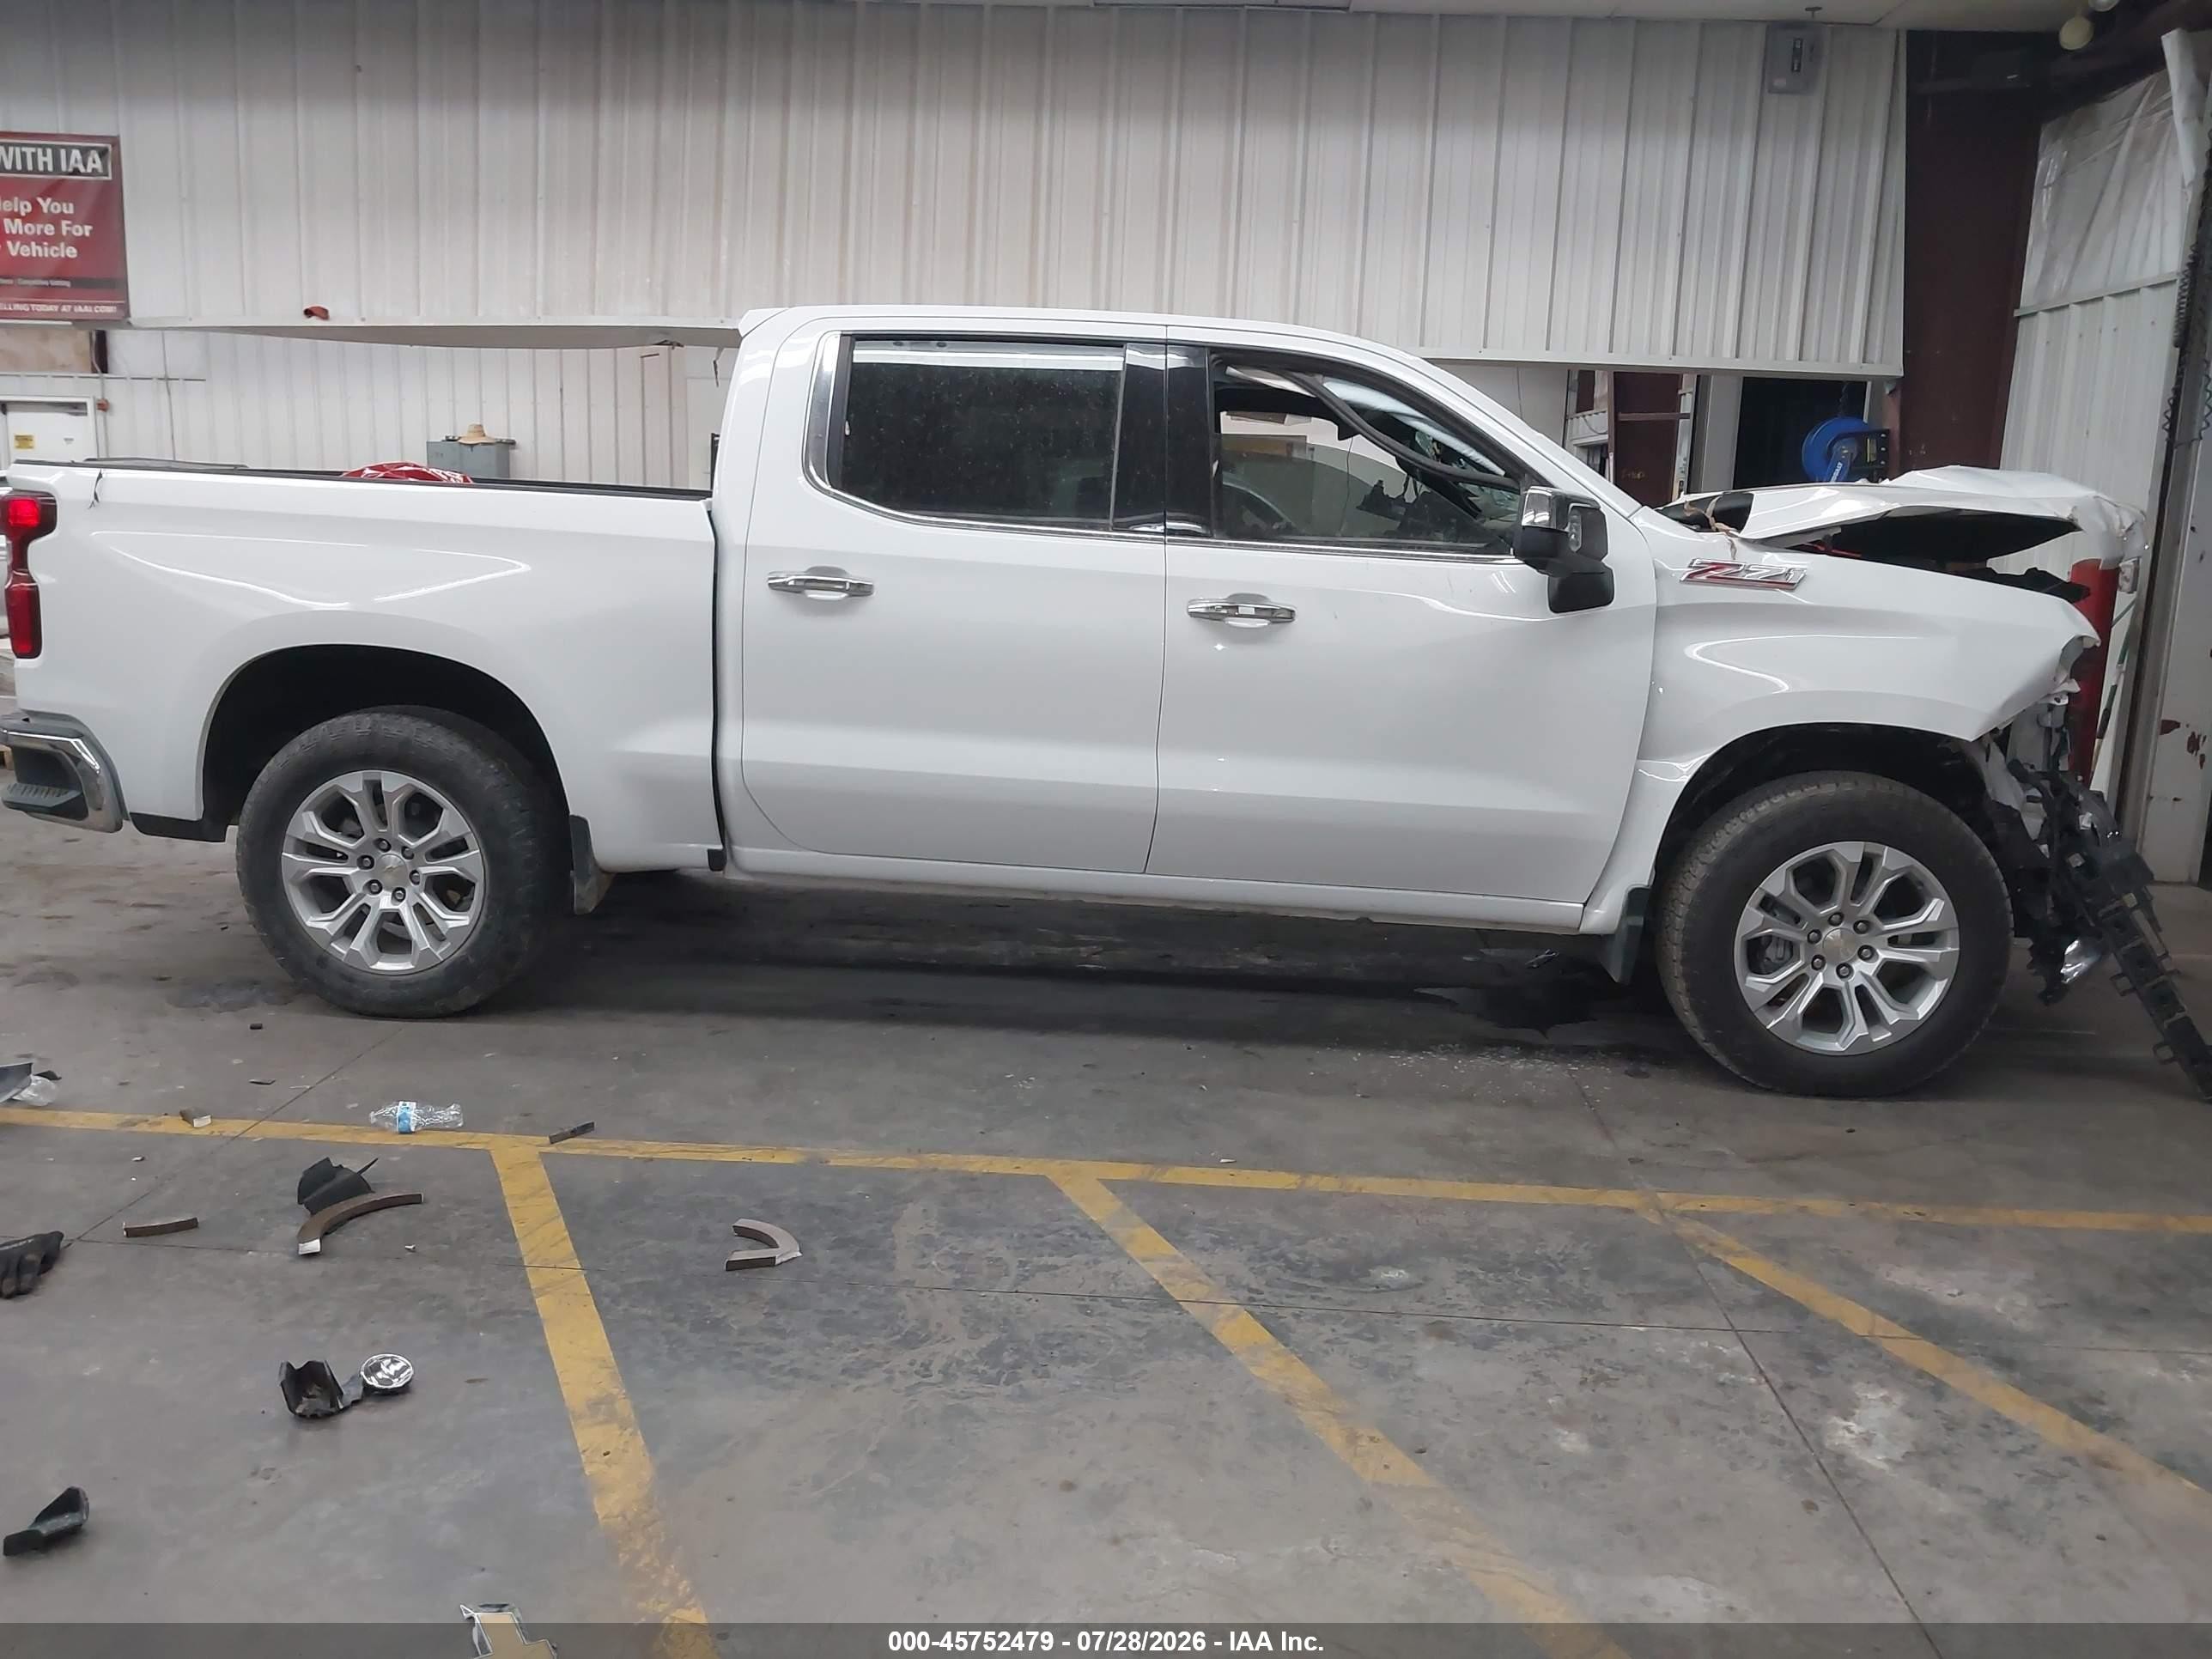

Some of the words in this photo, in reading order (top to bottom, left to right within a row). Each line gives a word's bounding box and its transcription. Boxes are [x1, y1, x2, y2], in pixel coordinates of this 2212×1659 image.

[59, 148, 103, 173] IAA
[0, 196, 32, 216] elp
[36, 197, 74, 214] You
[3, 218, 55, 236] More
[61, 220, 93, 237] For
[7, 240, 77, 258] Vehicle
[1680, 558, 1807, 591] Z71
